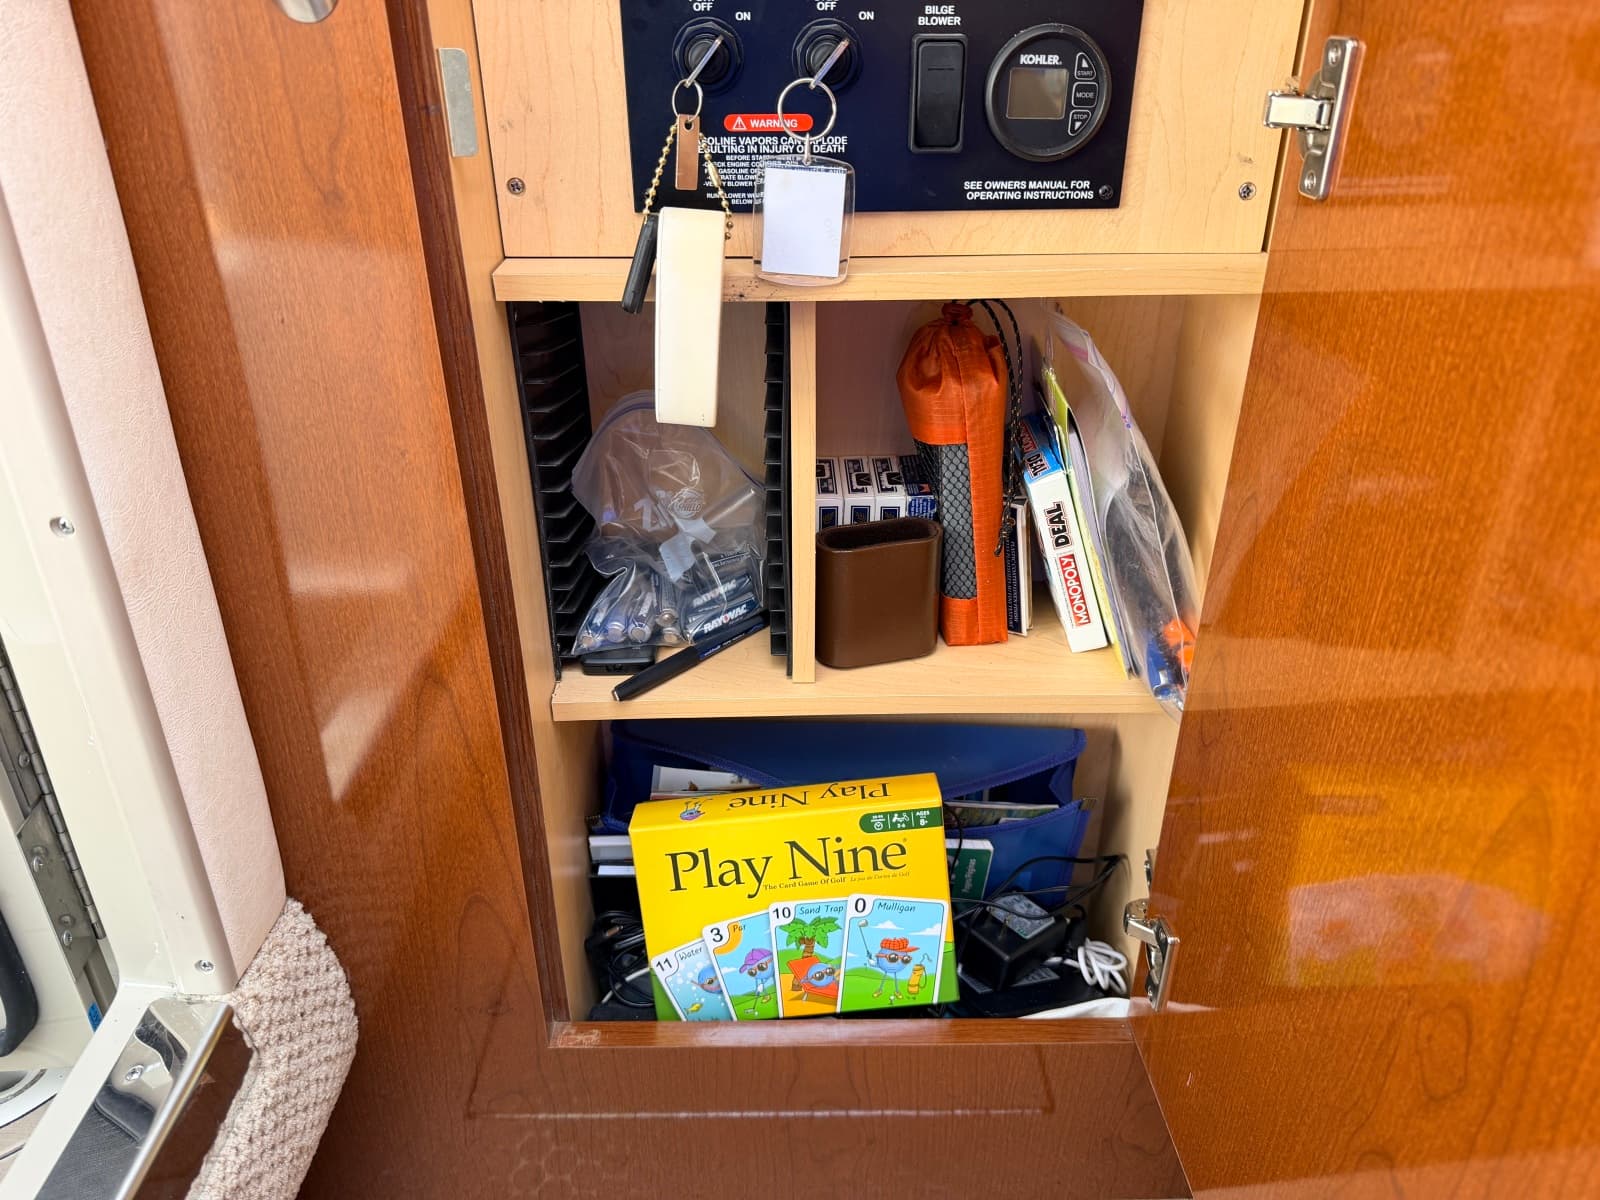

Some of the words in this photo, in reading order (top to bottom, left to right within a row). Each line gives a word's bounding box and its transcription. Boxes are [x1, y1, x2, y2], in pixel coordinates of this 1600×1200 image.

[693, 2, 713, 11] OFF
[816, 2, 836, 11] OFF
[924, 5, 955, 14] BILGE
[735, 11, 751, 21] ON
[858, 11, 874, 21] ON
[918, 16, 961, 26] BLOWER
[1020, 54, 1060, 65] KOHLER
[739, 136, 778, 145] VAPORS
[750, 145, 758, 154] IN
[760, 144, 794, 154] INJURY
[812, 144, 846, 153] DEATH
[964, 181, 983, 190] SEE
[984, 181, 1027, 190] OWNERS
[1029, 180, 1068, 190] MANUAL
[1070, 180, 1090, 189] FOR
[966, 191, 1022, 200] OPERATING
[1023, 190, 1094, 200] INSTRUCTIONS
[1025, 452, 1049, 478] DEAL
[1046, 502, 1070, 549] DEAL
[1060, 556, 1091, 626] MONOPOLY
[703, 603, 748, 634] RAYOVAC
[819, 782, 892, 800] Play
[730, 790, 810, 809] Nine
[665, 847, 773, 898] Play
[784, 836, 907, 880] Nine
[854, 897, 867, 914] 0
[877, 901, 916, 914] Mulligan
[773, 906, 791, 919] 10
[799, 906, 820, 915] Sand
[824, 905, 844, 914] Trap
[710, 927, 723, 942] 3
[732, 924, 746, 933] Par
[656, 957, 673, 972] 11
[678, 947, 703, 961] Water
